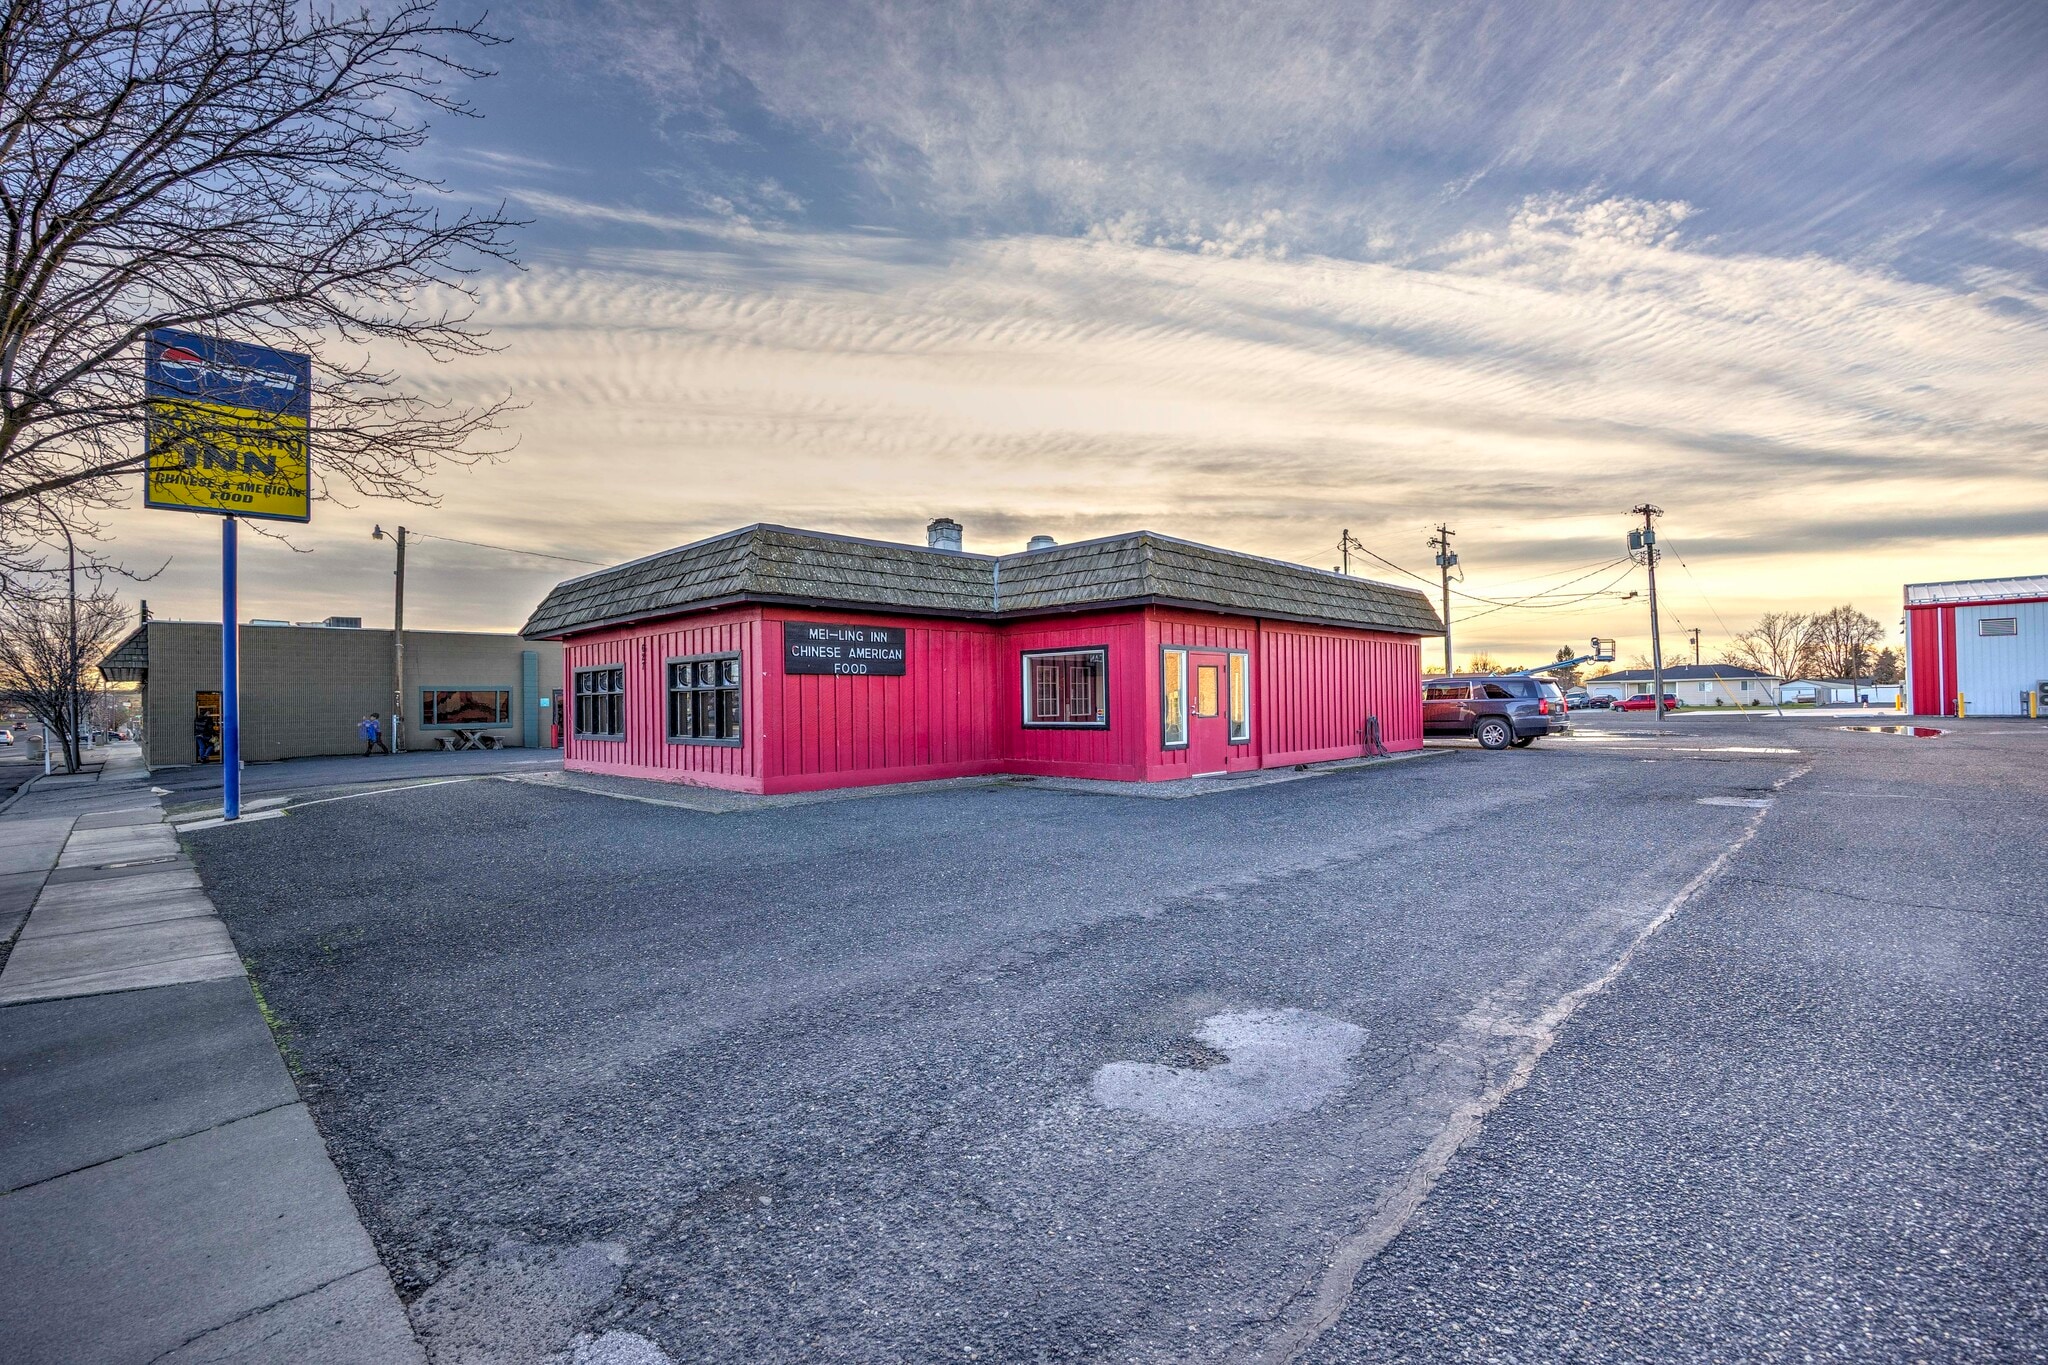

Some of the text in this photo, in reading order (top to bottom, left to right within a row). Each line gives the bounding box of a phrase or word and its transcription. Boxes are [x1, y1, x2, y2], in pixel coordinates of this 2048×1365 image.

[184, 443, 276, 476] INN
[155, 472, 301, 497] CHINESE & AMERICAN
[210, 491, 253, 503] FOOD
[809, 628, 887, 642] MEI-LING INN
[791, 645, 902, 660] CHINESE AMERICAN
[834, 663, 867, 674] FOOD
